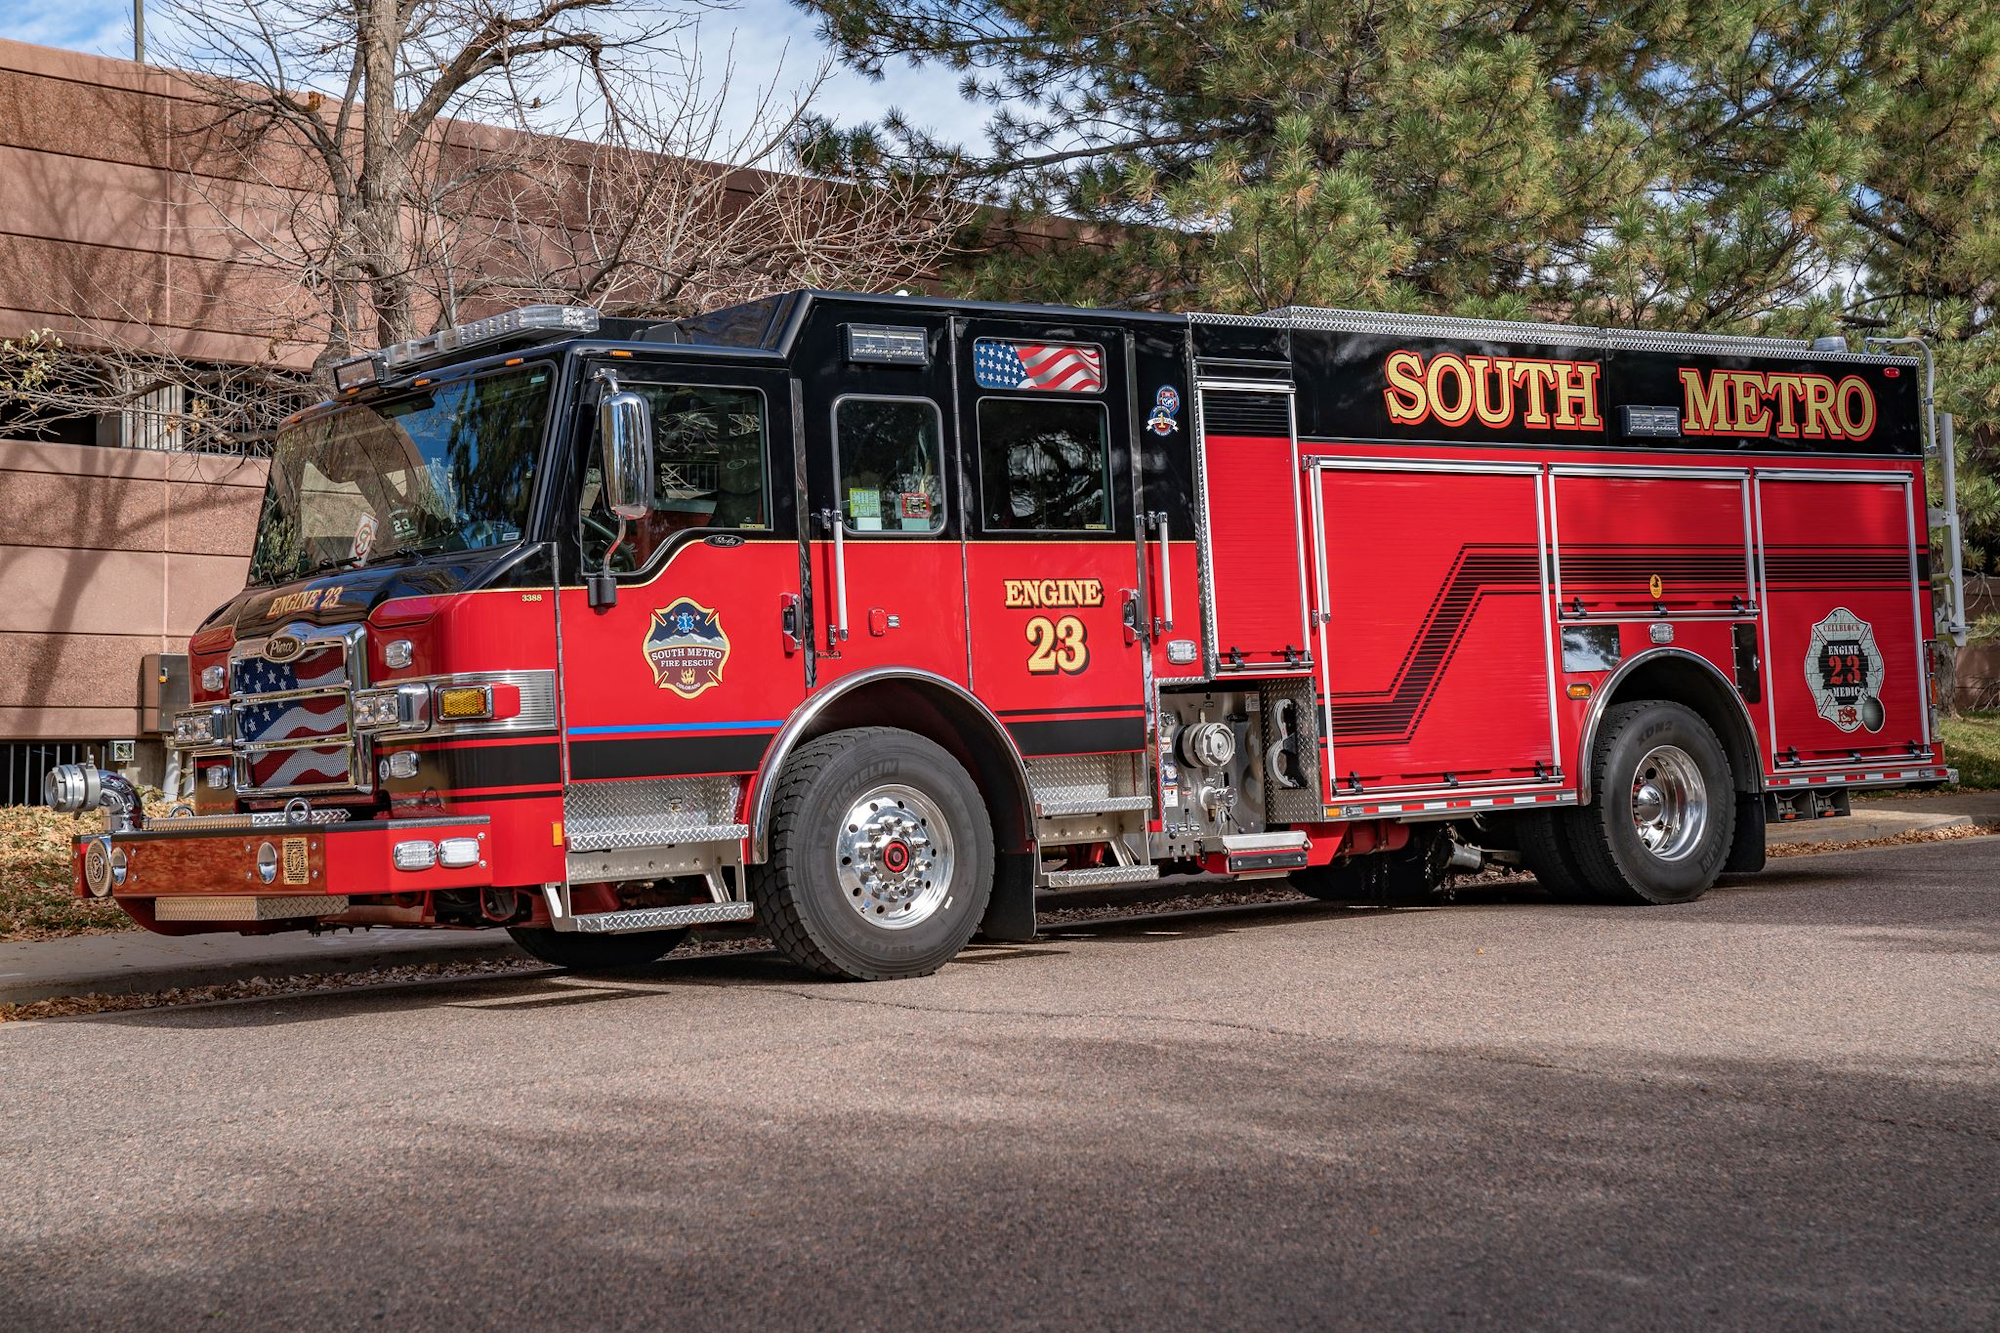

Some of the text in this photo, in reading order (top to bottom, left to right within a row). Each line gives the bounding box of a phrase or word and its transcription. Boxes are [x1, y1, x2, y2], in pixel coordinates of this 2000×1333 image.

[1384, 350, 1877, 441] SOUTH METRO
[393, 518, 410, 532] 23
[521, 594, 542, 602] 3388
[1003, 578, 1105, 609] ENGINE
[266, 587, 343, 618] ENGINE 23
[1823, 623, 1861, 632] CELLBLOCK
[270, 640, 294, 656] Pierce
[1025, 615, 1090, 675] 23
[1828, 645, 1860, 655] ENGINE
[651, 647, 722, 661] SOUTH METRO
[682, 659, 714, 667] RESCUE
[1828, 655, 1861, 685] 23
[675, 682, 701, 691] COLORADO
[1832, 686, 1861, 698] MEDIC
[826, 758, 900, 820] MICHELIN
